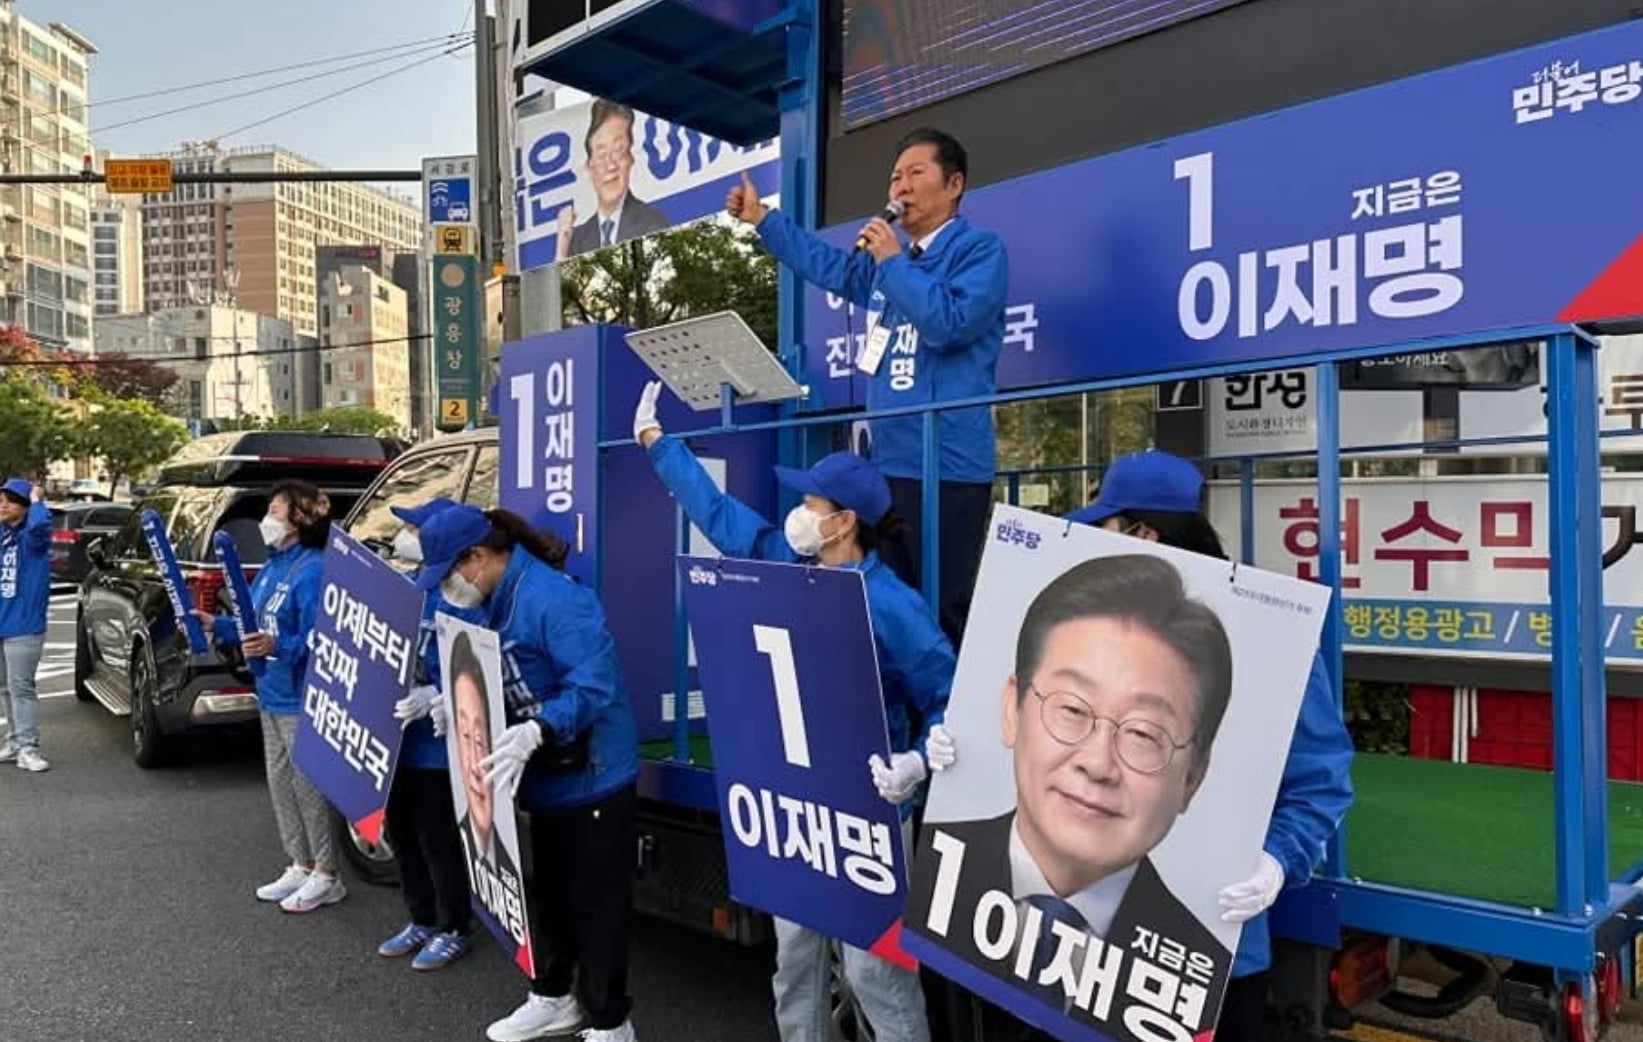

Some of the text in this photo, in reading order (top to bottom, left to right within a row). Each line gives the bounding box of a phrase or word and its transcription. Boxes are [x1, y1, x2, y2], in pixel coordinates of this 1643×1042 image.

[1513, 61, 1643, 124] 민주당
[1174, 152, 1214, 253] 1
[1351, 169, 1463, 221] 지금은
[1177, 214, 1465, 341] 이재명
[449, 400, 461, 417] 2
[889, 320, 919, 392] 재명
[510, 372, 534, 489] 1
[545, 358, 574, 514] 이재명
[323, 583, 411, 686] 이제부터
[1343, 605, 1496, 643] 행정용광고
[304, 683, 391, 793] 대한민국
[753, 624, 811, 769] 1
[728, 783, 898, 895] 이재명
[926, 830, 967, 938] 1
[972, 889, 1220, 1042] 이재명
[1130, 925, 1215, 986] 지금은
